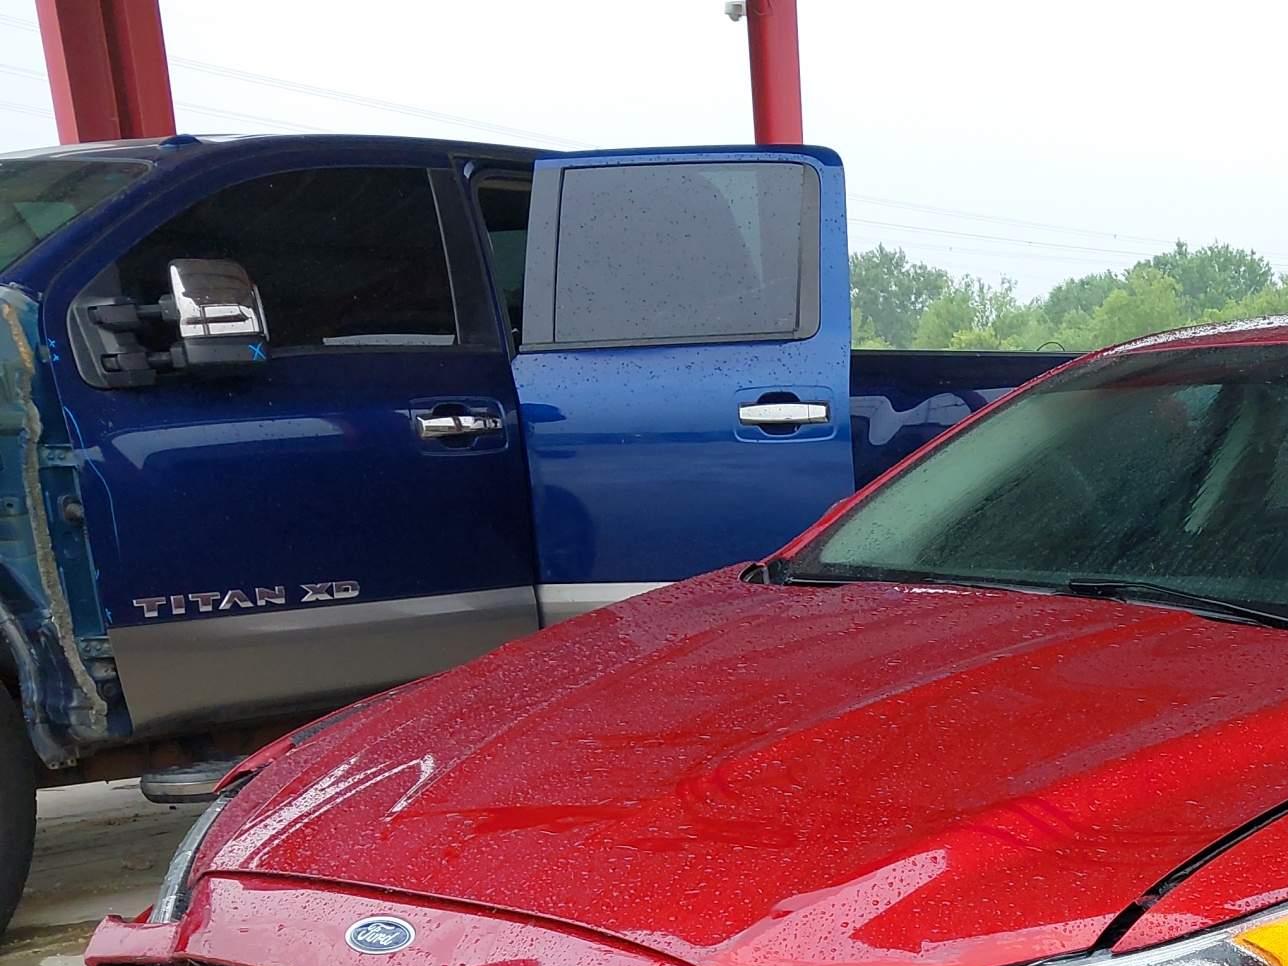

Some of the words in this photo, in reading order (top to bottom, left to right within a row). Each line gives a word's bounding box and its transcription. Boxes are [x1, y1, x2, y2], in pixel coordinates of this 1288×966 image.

[133, 585, 286, 618] TITAN
[300, 580, 360, 602] XD
[357, 922, 401, 946] Ford
